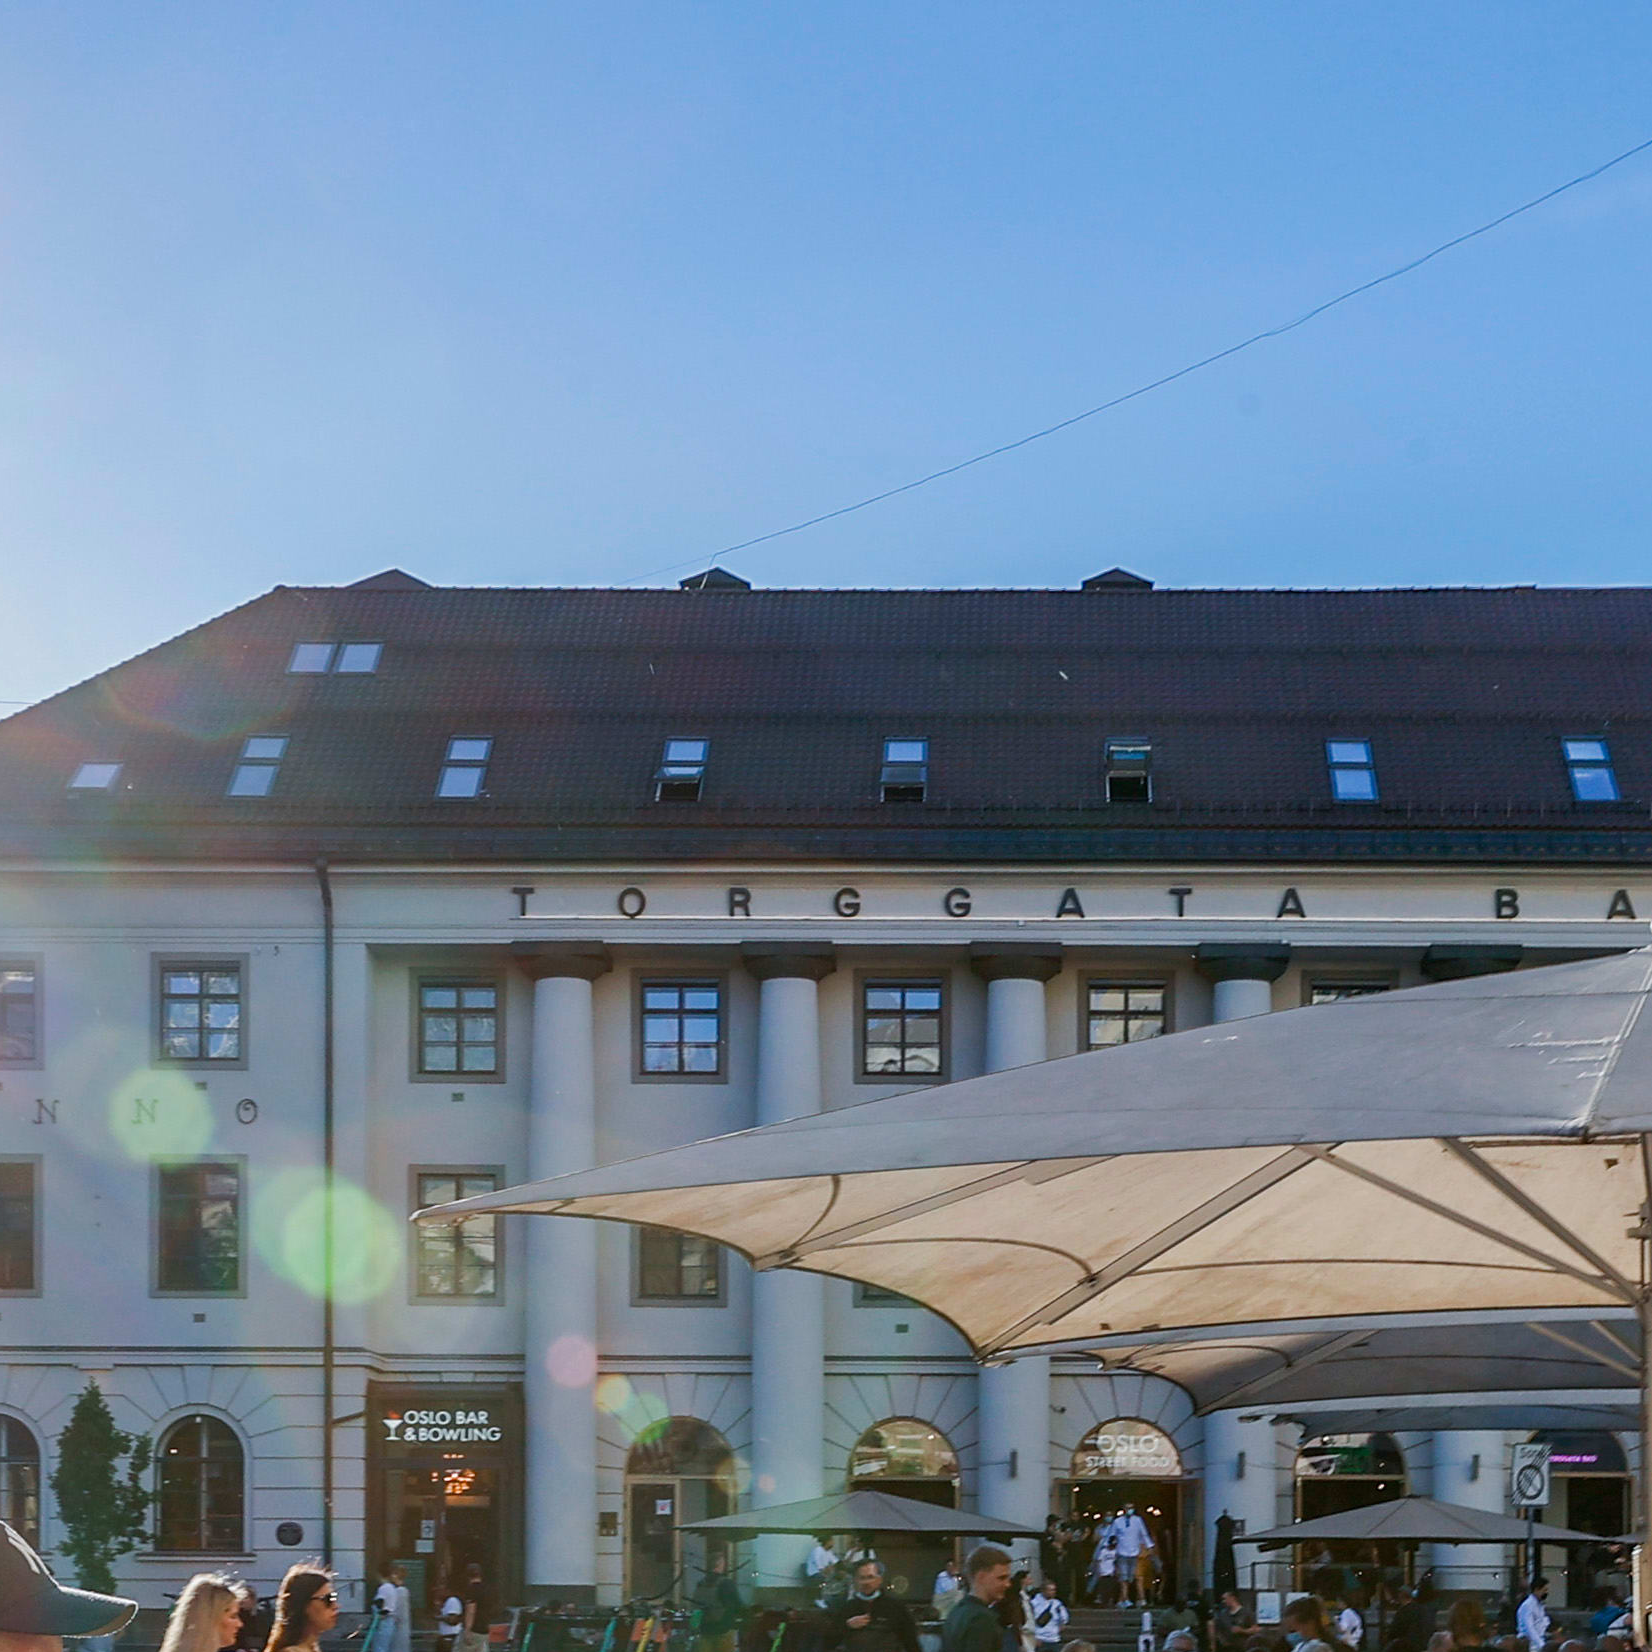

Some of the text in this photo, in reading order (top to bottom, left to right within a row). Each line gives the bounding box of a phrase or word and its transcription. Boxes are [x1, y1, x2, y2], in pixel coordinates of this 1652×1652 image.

[512, 889, 1309, 920] TORGGATA
[403, 1410, 489, 1425] OSLO BAR
[1096, 1434, 1159, 1453] OSLO
[1085, 1455, 1171, 1468] STREET FOOD
